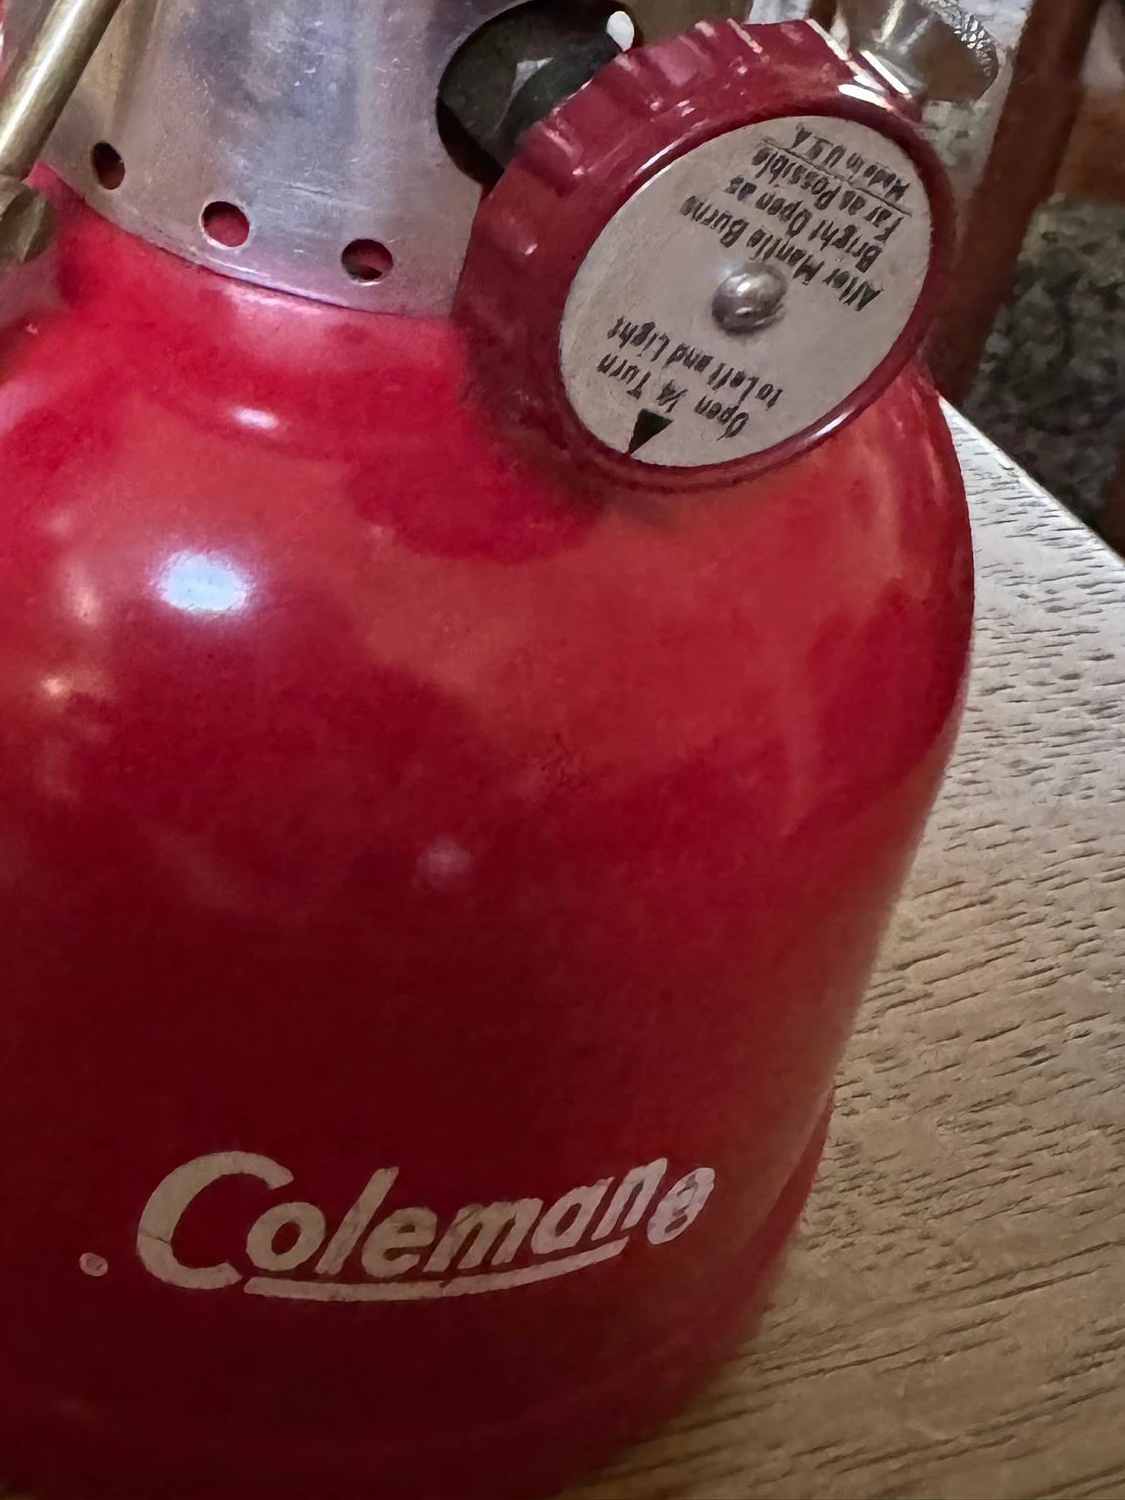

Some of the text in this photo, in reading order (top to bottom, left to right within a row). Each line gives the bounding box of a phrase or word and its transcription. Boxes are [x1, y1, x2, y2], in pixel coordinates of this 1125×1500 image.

[725, 175, 883, 273] Bright Open as
[751, 147, 904, 244] Far as Possible
[863, 165, 910, 201] Made
[680, 196, 884, 311] After Mantle Burns
[597, 353, 651, 400] Turn
[607, 316, 783, 411] to Left and Light
[694, 396, 749, 438] Open
